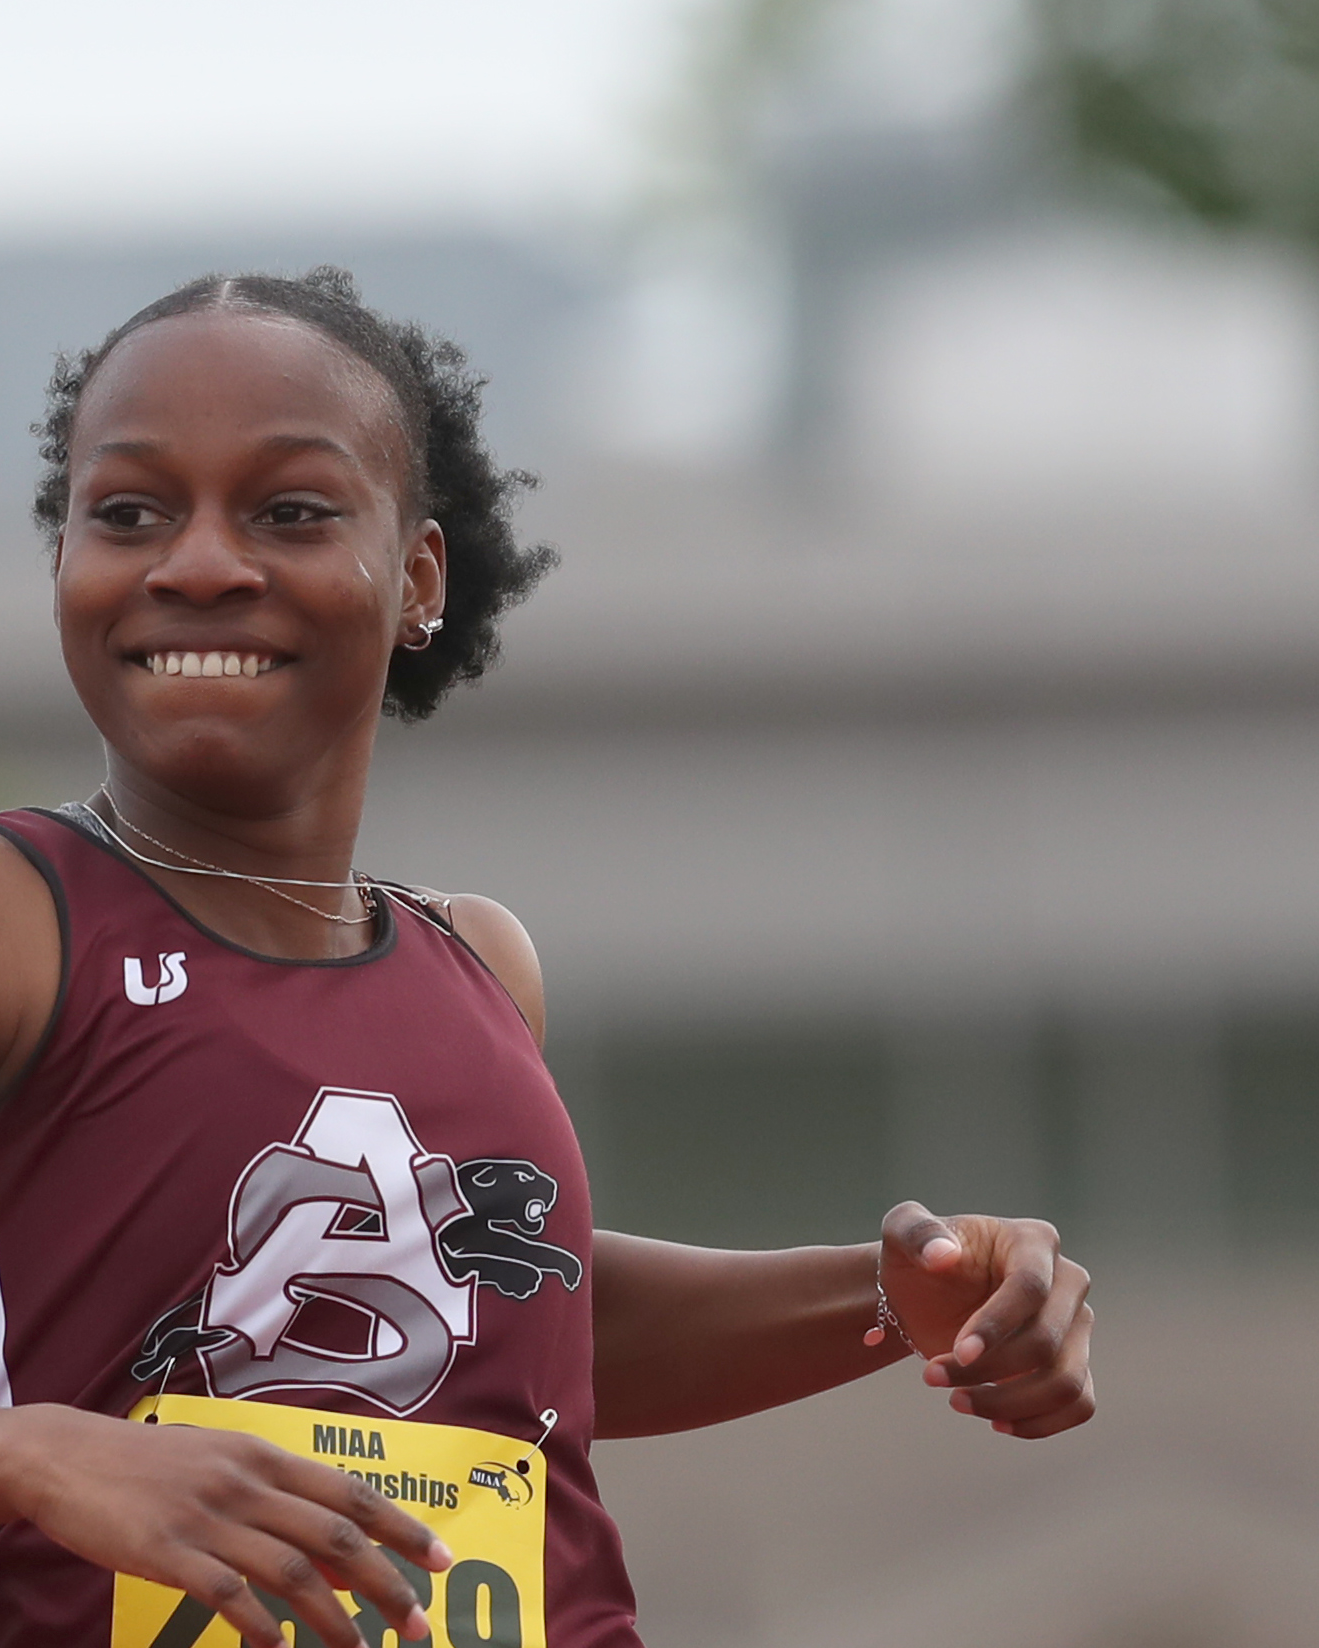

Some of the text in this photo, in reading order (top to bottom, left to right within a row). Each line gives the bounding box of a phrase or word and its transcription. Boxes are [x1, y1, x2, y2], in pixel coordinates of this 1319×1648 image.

[123, 951, 188, 1006] US
[312, 1423, 386, 1461] MIAA
[336, 1463, 460, 1510] nships
[470, 1470, 501, 1488] MIAA
